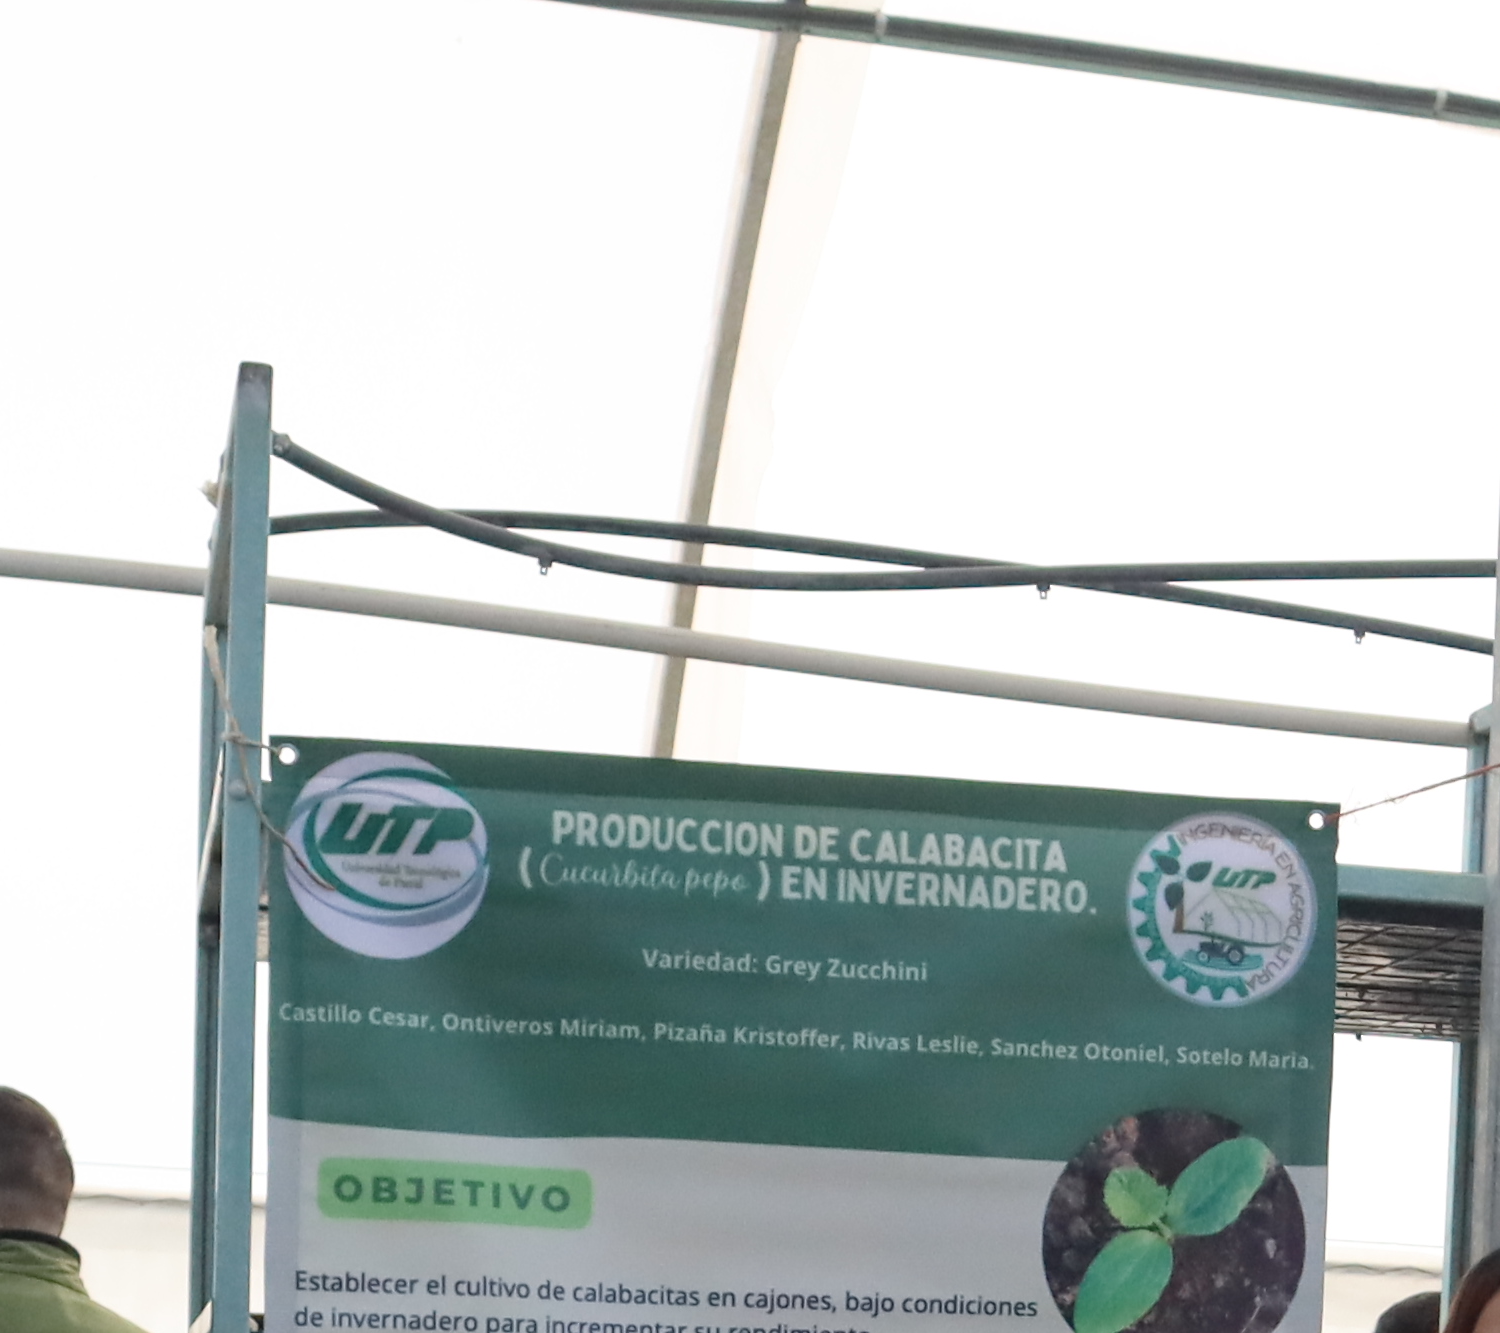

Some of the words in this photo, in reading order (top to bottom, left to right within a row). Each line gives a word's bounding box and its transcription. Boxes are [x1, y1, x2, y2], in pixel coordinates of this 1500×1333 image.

[318, 802, 474, 855] UTP
[552, 809, 784, 858] PRODUCCION
[794, 825, 840, 863] DE
[850, 829, 1067, 873] CALABACITA
[540, 852, 680, 889] Cucurbita
[684, 867, 749, 897] pepo
[781, 866, 827, 900] EN
[838, 870, 1096, 914] INVERNADERO.
[1212, 867, 1277, 889] UTP
[1275, 852, 1296, 879] EN
[1246, 882, 1305, 990] AGRICULTURA
[642, 949, 757, 972] Variedad:
[765, 955, 821, 981] Grey
[827, 958, 927, 981] Zucchini
[280, 1003, 362, 1023] Castillo
[369, 1007, 435, 1031] Cesar,
[442, 1013, 553, 1035] Ontiveros
[561, 1019, 645, 1041] Miriam,
[654, 1023, 726, 1043] Pizaña
[734, 1027, 845, 1051] Kristoffer,
[853, 1032, 910, 1051] Rivas
[917, 1035, 983, 1056] Leslie,
[991, 1038, 1078, 1059] Sanchez
[1084, 1043, 1169, 1065] Otoniel,
[1177, 1046, 1242, 1066] Sotelo
[1250, 1051, 1313, 1069] Maria.
[332, 1174, 572, 1214] OBJETIVO
[295, 1271, 419, 1294] Establecer
[426, 1275, 446, 1295] el
[454, 1276, 530, 1299] cultivo
[537, 1280, 565, 1301] de
[573, 1283, 700, 1306] calabacitas
[707, 1292, 736, 1307] en
[744, 1289, 836, 1314] cajones,
[846, 1291, 894, 1318] bajo
[902, 1295, 1037, 1317] condiciones
[294, 1307, 323, 1327] de
[332, 1309, 478, 1332] invernadero
